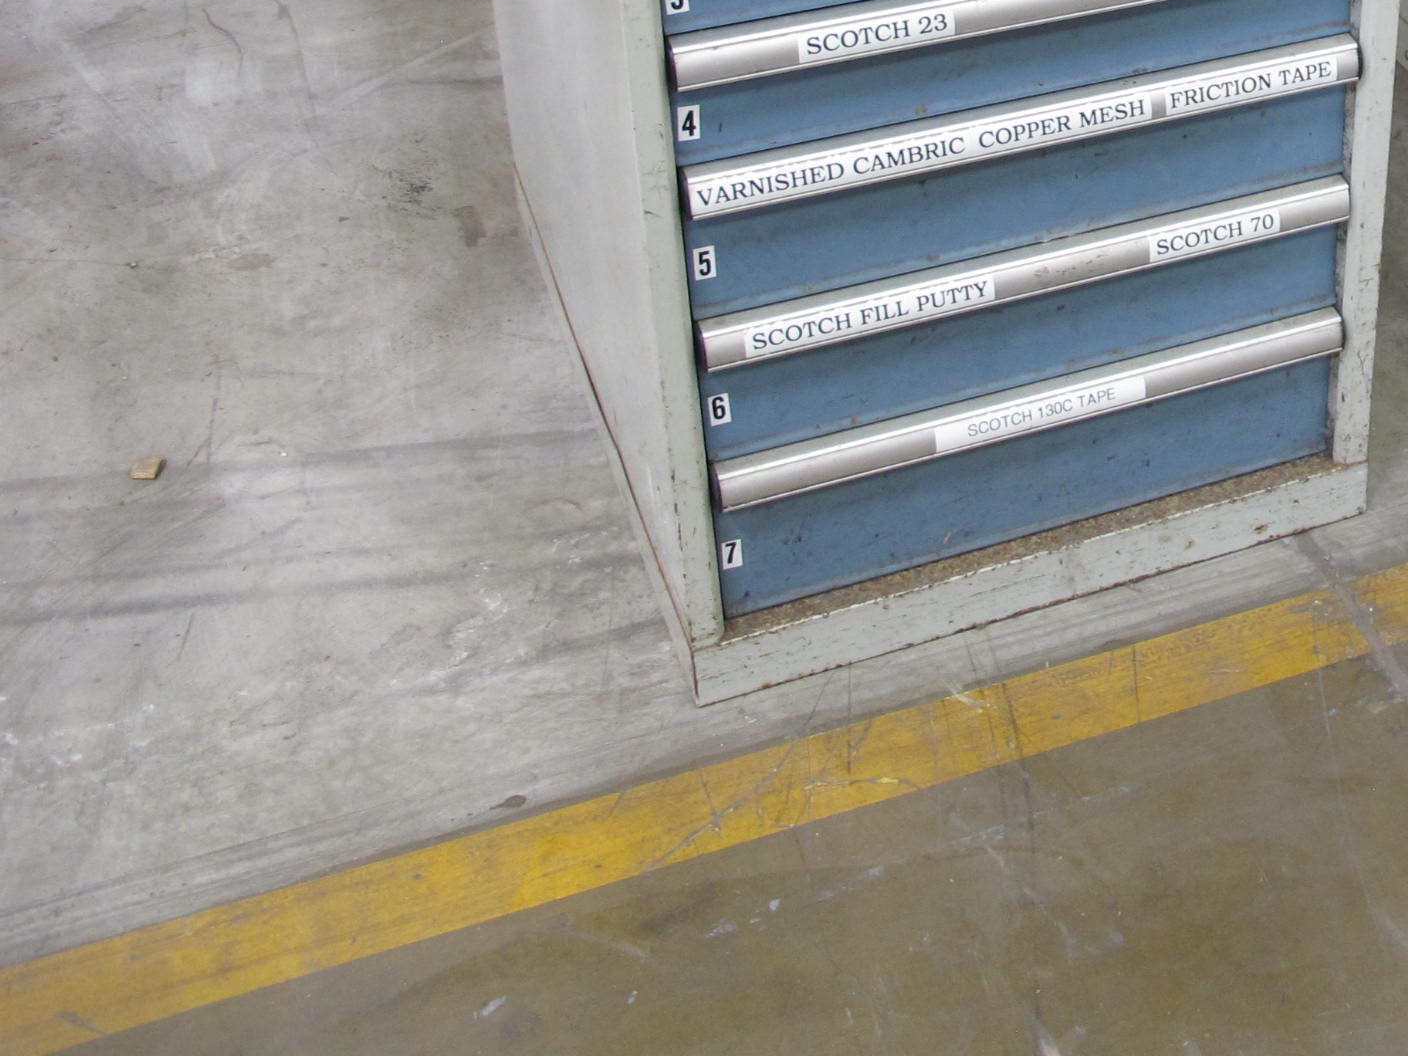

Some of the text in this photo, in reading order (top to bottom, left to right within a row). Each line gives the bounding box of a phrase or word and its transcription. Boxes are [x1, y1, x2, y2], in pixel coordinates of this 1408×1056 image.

[806, 13, 948, 55] SCOTCH 23
[1169, 61, 1332, 109] FRICTION TAPE
[681, 110, 696, 136] 4
[978, 100, 1146, 149] COPPER MESH
[696, 137, 966, 207] VARNISHED CAMBRIC
[1156, 214, 1275, 255] SCOTCH 70
[699, 251, 712, 277] 5
[752, 280, 989, 350] SCOTCH FILL PUTTY
[711, 396, 726, 420] 6
[967, 387, 1117, 437] SCOTCH 130C TAPE
[725, 542, 738, 565] 7
